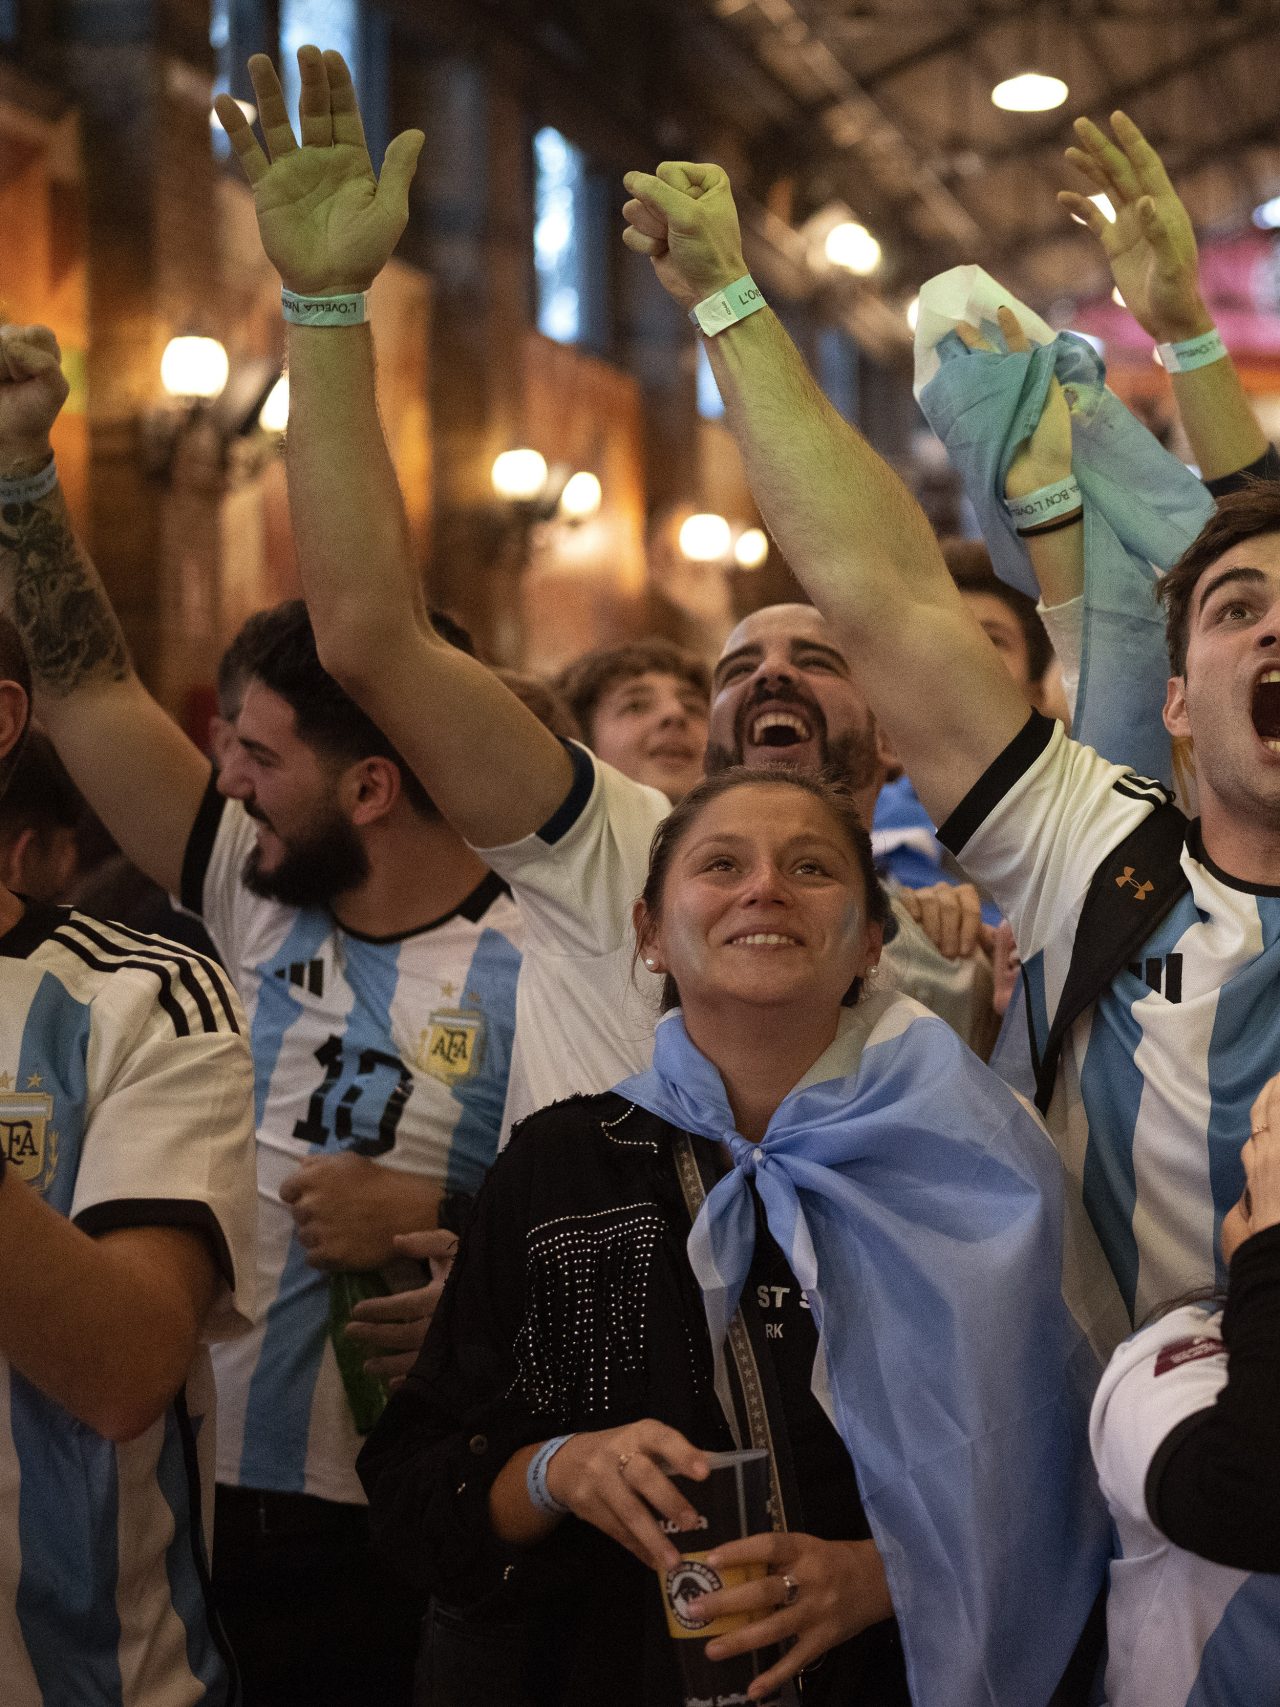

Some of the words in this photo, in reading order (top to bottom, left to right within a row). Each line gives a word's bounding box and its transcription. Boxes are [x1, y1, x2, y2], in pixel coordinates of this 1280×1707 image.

[1045, 489, 1070, 508] BCN
[432, 1028, 469, 1064] AFA
[292, 1034, 415, 1157] 10
